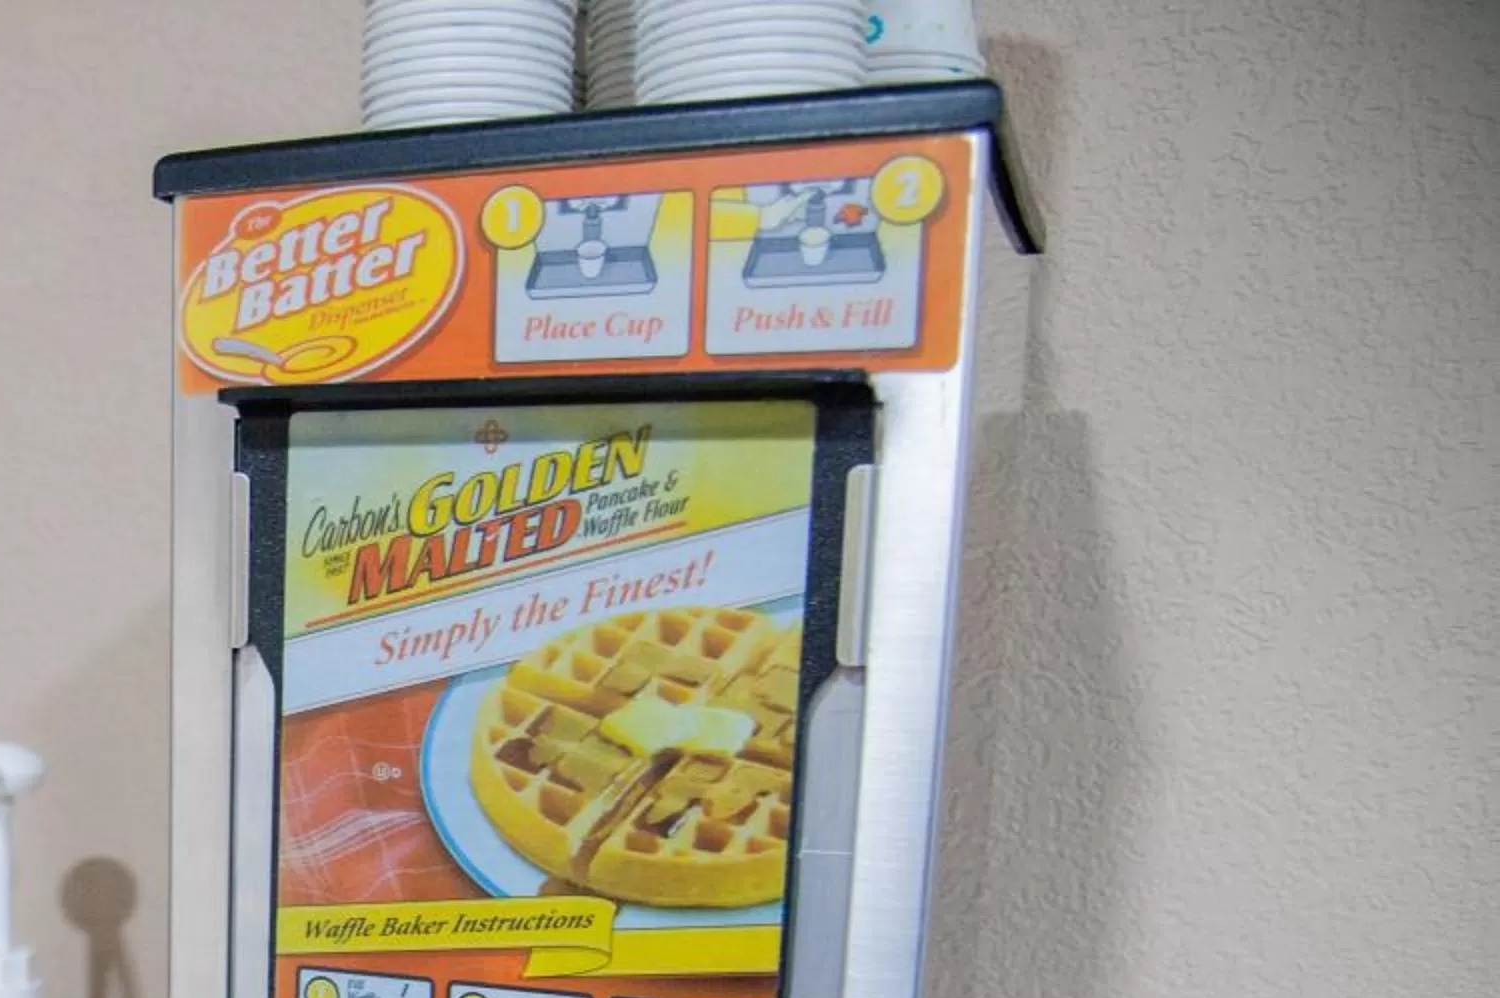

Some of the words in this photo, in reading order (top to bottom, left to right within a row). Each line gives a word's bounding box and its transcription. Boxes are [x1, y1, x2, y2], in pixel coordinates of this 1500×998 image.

[896, 171, 920, 208] 2
[508, 197, 522, 233] 1
[201, 199, 393, 302] Better
[235, 231, 425, 332] Batter
[308, 287, 409, 331] Dispenser
[523, 312, 596, 341] Place
[604, 311, 665, 343] Cup
[733, 303, 805, 333] Push
[810, 308, 832, 329] &
[841, 297, 895, 329] Fill
[302, 491, 400, 559] Carbon's
[407, 424, 652, 537] GOLDEN
[586, 476, 660, 513] Pancake
[663, 469, 679, 492] &
[583, 506, 639, 538] Waffle
[643, 496, 690, 523] Flour
[347, 498, 583, 606] MALTED
[373, 606, 501, 667] Simply
[510, 592, 569, 632] the
[577, 550, 716, 614] Finest!
[304, 917, 376, 944] Waffle
[379, 916, 449, 938] Baker
[453, 910, 596, 934] Instructions
